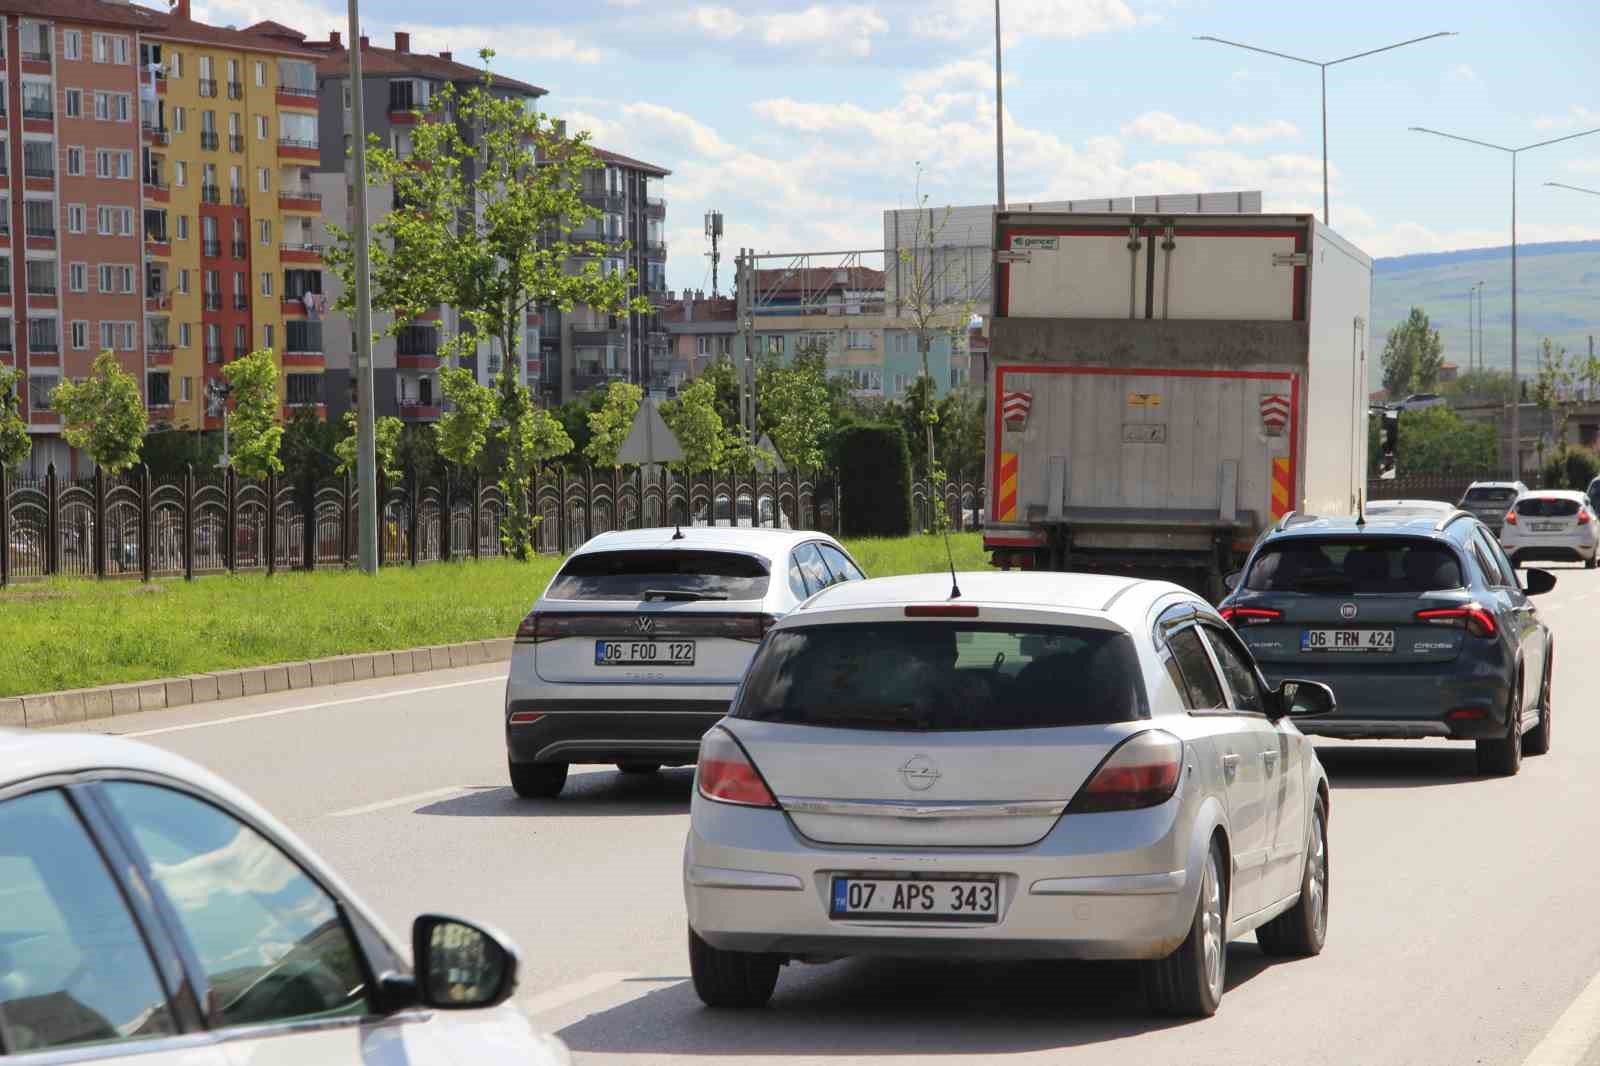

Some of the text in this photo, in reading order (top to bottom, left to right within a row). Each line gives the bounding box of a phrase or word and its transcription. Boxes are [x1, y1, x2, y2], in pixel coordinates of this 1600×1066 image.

[1310, 631, 1393, 646] 06 FRN 424
[606, 643, 622, 660] 06
[669, 643, 692, 660] 122
[849, 882, 993, 911] 07 APS 343
